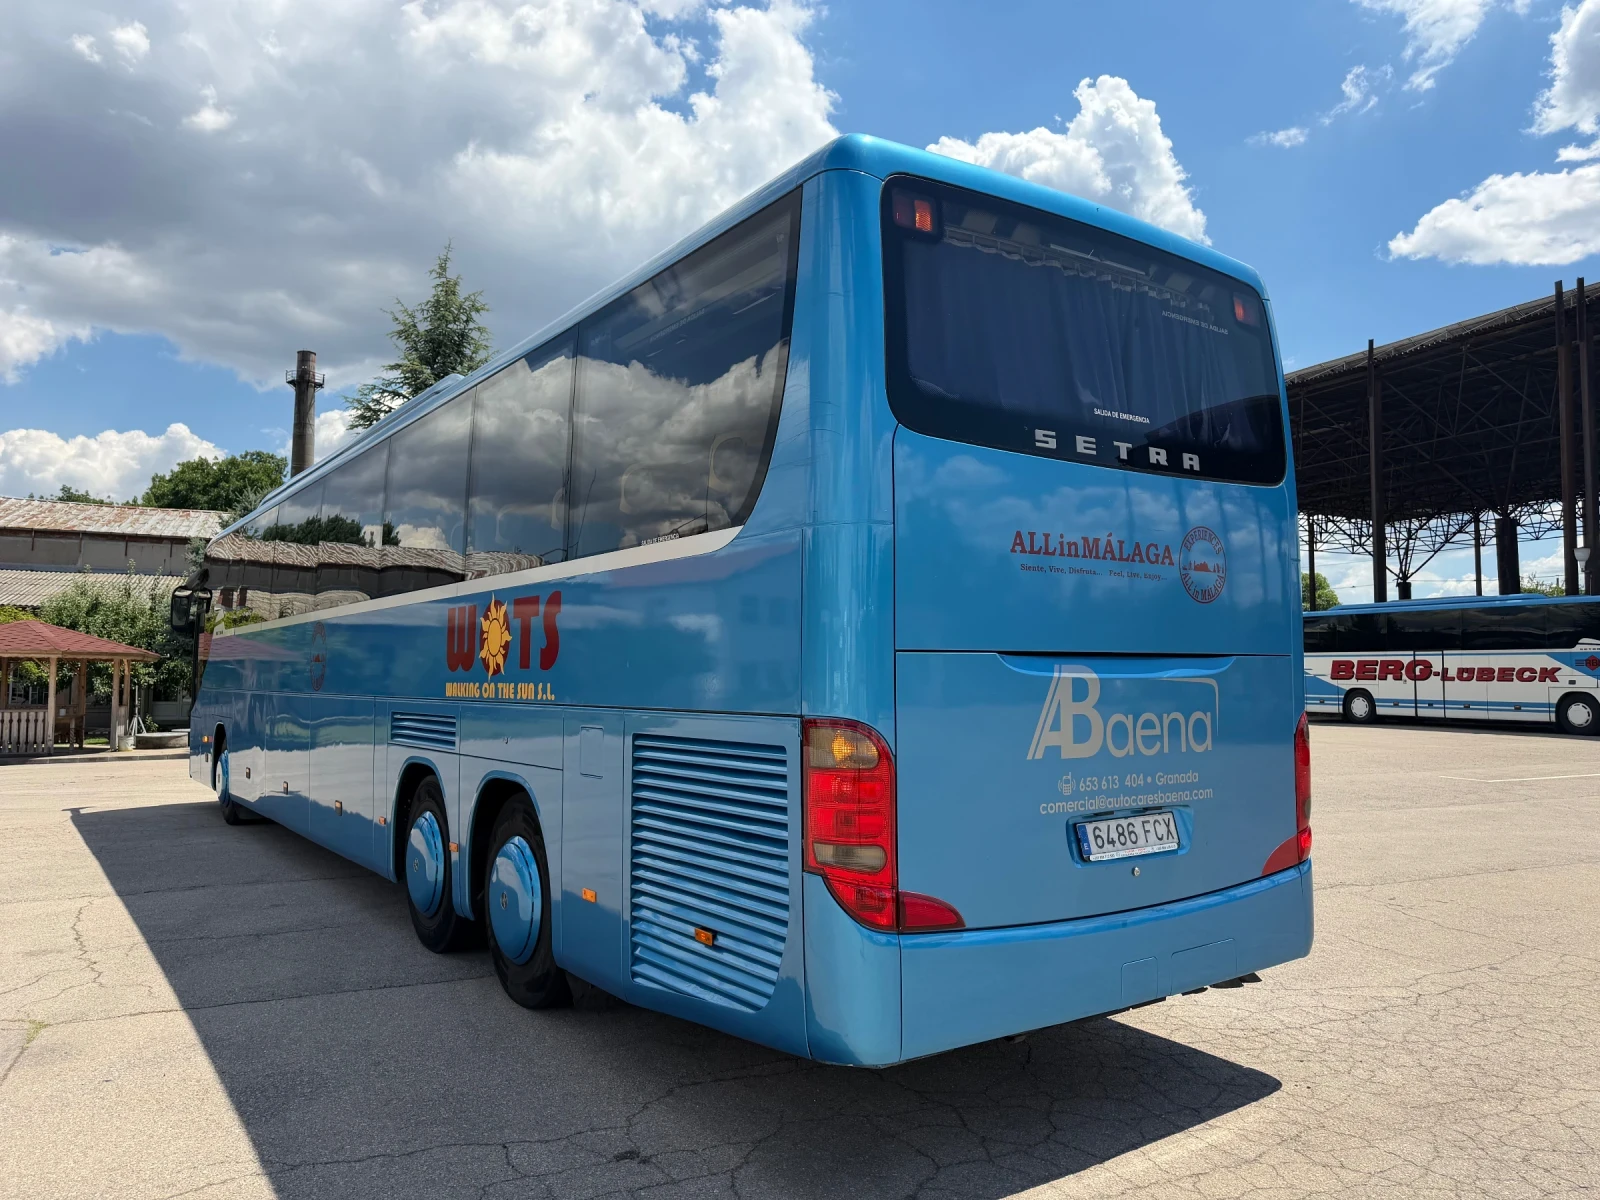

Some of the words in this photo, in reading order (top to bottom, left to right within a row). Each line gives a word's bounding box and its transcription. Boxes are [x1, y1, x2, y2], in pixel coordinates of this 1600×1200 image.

[1093, 407, 1112, 417] SALIDA
[1111, 411, 1120, 419] DE
[1119, 412, 1151, 424] EMERGENCIA
[1034, 428, 1201, 472] SETRA
[1183, 528, 1224, 556] EXPERIENCES
[1020, 563, 1047, 573] Siente,
[1048, 565, 1067, 575] Vive,
[1108, 569, 1125, 578] Feel,
[1200, 574, 1226, 601] MÁLAGA
[446, 590, 562, 677] WOTS
[445, 682, 480, 698] WALKING
[481, 682, 495, 699] ON
[497, 682, 515, 699] THE
[517, 682, 535, 700] SUN
[537, 682, 555, 701] S.L.
[1079, 779, 1098, 792] 653
[1101, 776, 1119, 790] 613
[1125, 773, 1144, 787] 404
[1155, 770, 1199, 786] Granada
[1039, 787, 1214, 815] comercial@autocaresbaena.com
[1092, 822, 1139, 850] 6486
[1141, 817, 1175, 844] FCX
